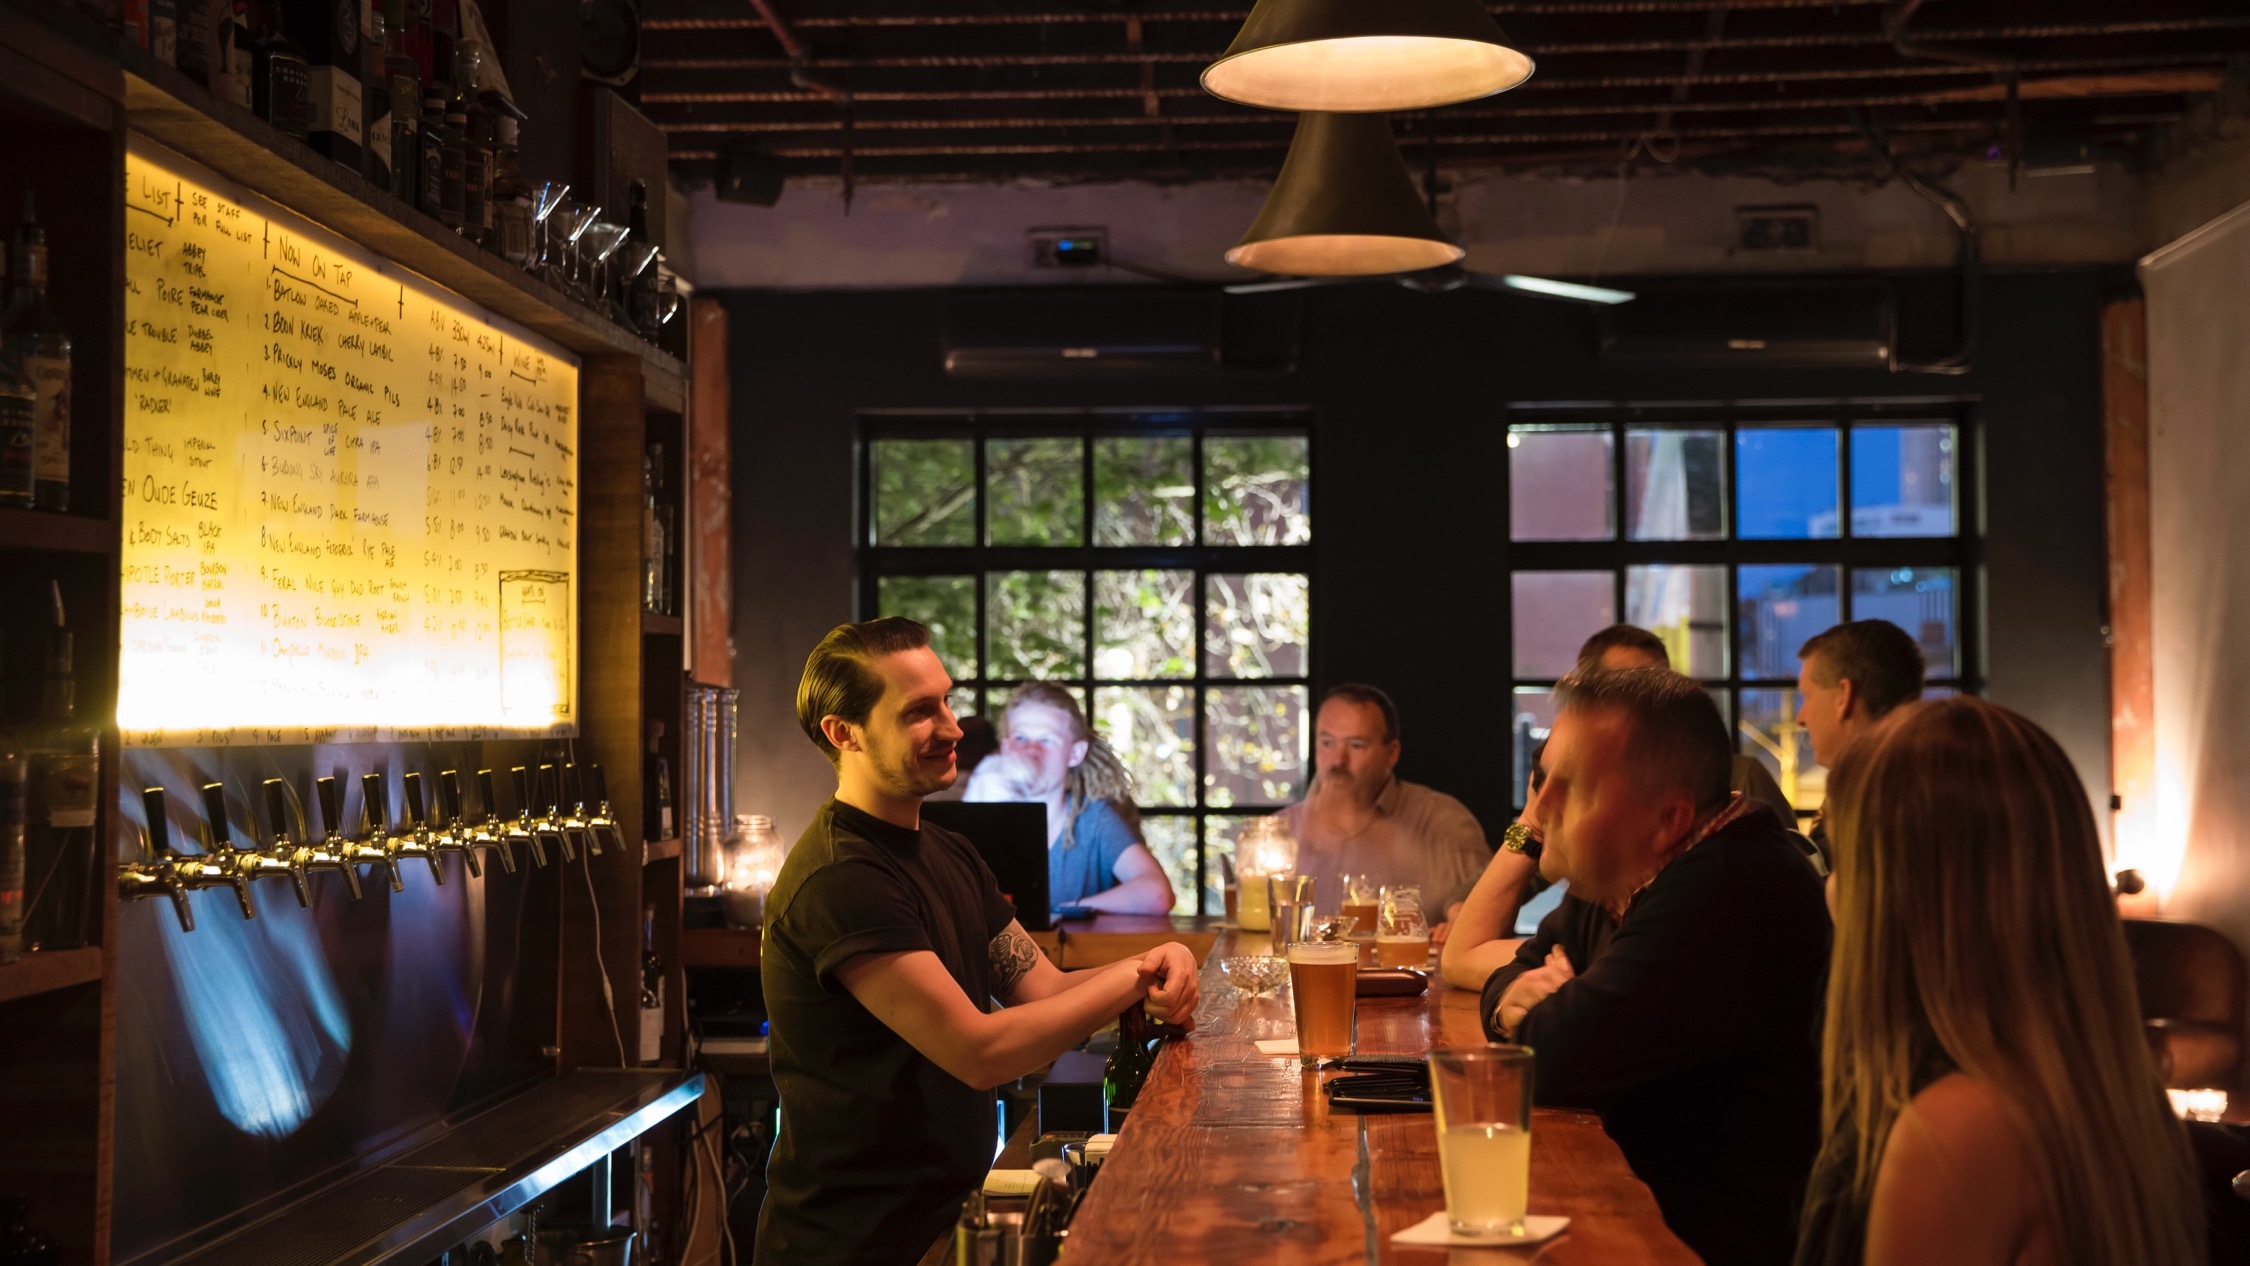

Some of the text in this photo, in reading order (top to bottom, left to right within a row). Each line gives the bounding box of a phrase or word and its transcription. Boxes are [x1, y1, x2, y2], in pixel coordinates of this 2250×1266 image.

[143, 175, 171, 210] LIST
[192, 192, 241, 220] SEE STAFF
[216, 220, 231, 237] FULL
[236, 231, 252, 244] LIST
[183, 242, 206, 265] ABBEY
[280, 235, 353, 289] NOW ON TAP
[156, 278, 184, 306] POIRE
[274, 279, 307, 306] BATLOW
[315, 296, 339, 316] OAKED
[191, 300, 209, 317] PEAR
[430, 309, 445, 332] ABV
[142, 322, 178, 344] TROUBLE
[273, 311, 294, 336] BOON
[300, 318, 324, 346] KRIEK
[338, 333, 365, 359] CHERRY
[190, 340, 213, 357] ABBEY
[273, 342, 303, 375] PRICKLY
[311, 360, 337, 380] MOSES
[345, 371, 374, 394] ORGANIC
[384, 385, 400, 408] PILS
[273, 380, 290, 404] NEW
[296, 386, 328, 412] ENGLAND
[338, 399, 358, 421] PALE
[366, 409, 381, 426] ALE
[145, 437, 173, 463] THING
[273, 420, 313, 446] SIXPOINT
[370, 439, 381, 456] IPA
[189, 456, 212, 469] STOUT
[143, 474, 176, 504] OUDE
[182, 480, 218, 511] GEUZE
[270, 492, 289, 514] NEW
[293, 493, 323, 519] ENGLAND
[330, 503, 348, 521] DARK
[353, 508, 389, 527] FARMHOUSE
[139, 521, 162, 546] BODY
[166, 525, 190, 548] SALTS
[198, 521, 222, 538] BLACK
[203, 540, 215, 556] IPA
[269, 533, 286, 554] NEW
[289, 532, 321, 559] ENGLAND
[363, 538, 375, 560] RYE
[381, 540, 396, 560] PALE
[164, 565, 195, 588] PORTER
[272, 568, 297, 591] FERAL
[305, 573, 324, 594] NICE
[331, 579, 345, 599] GUY
